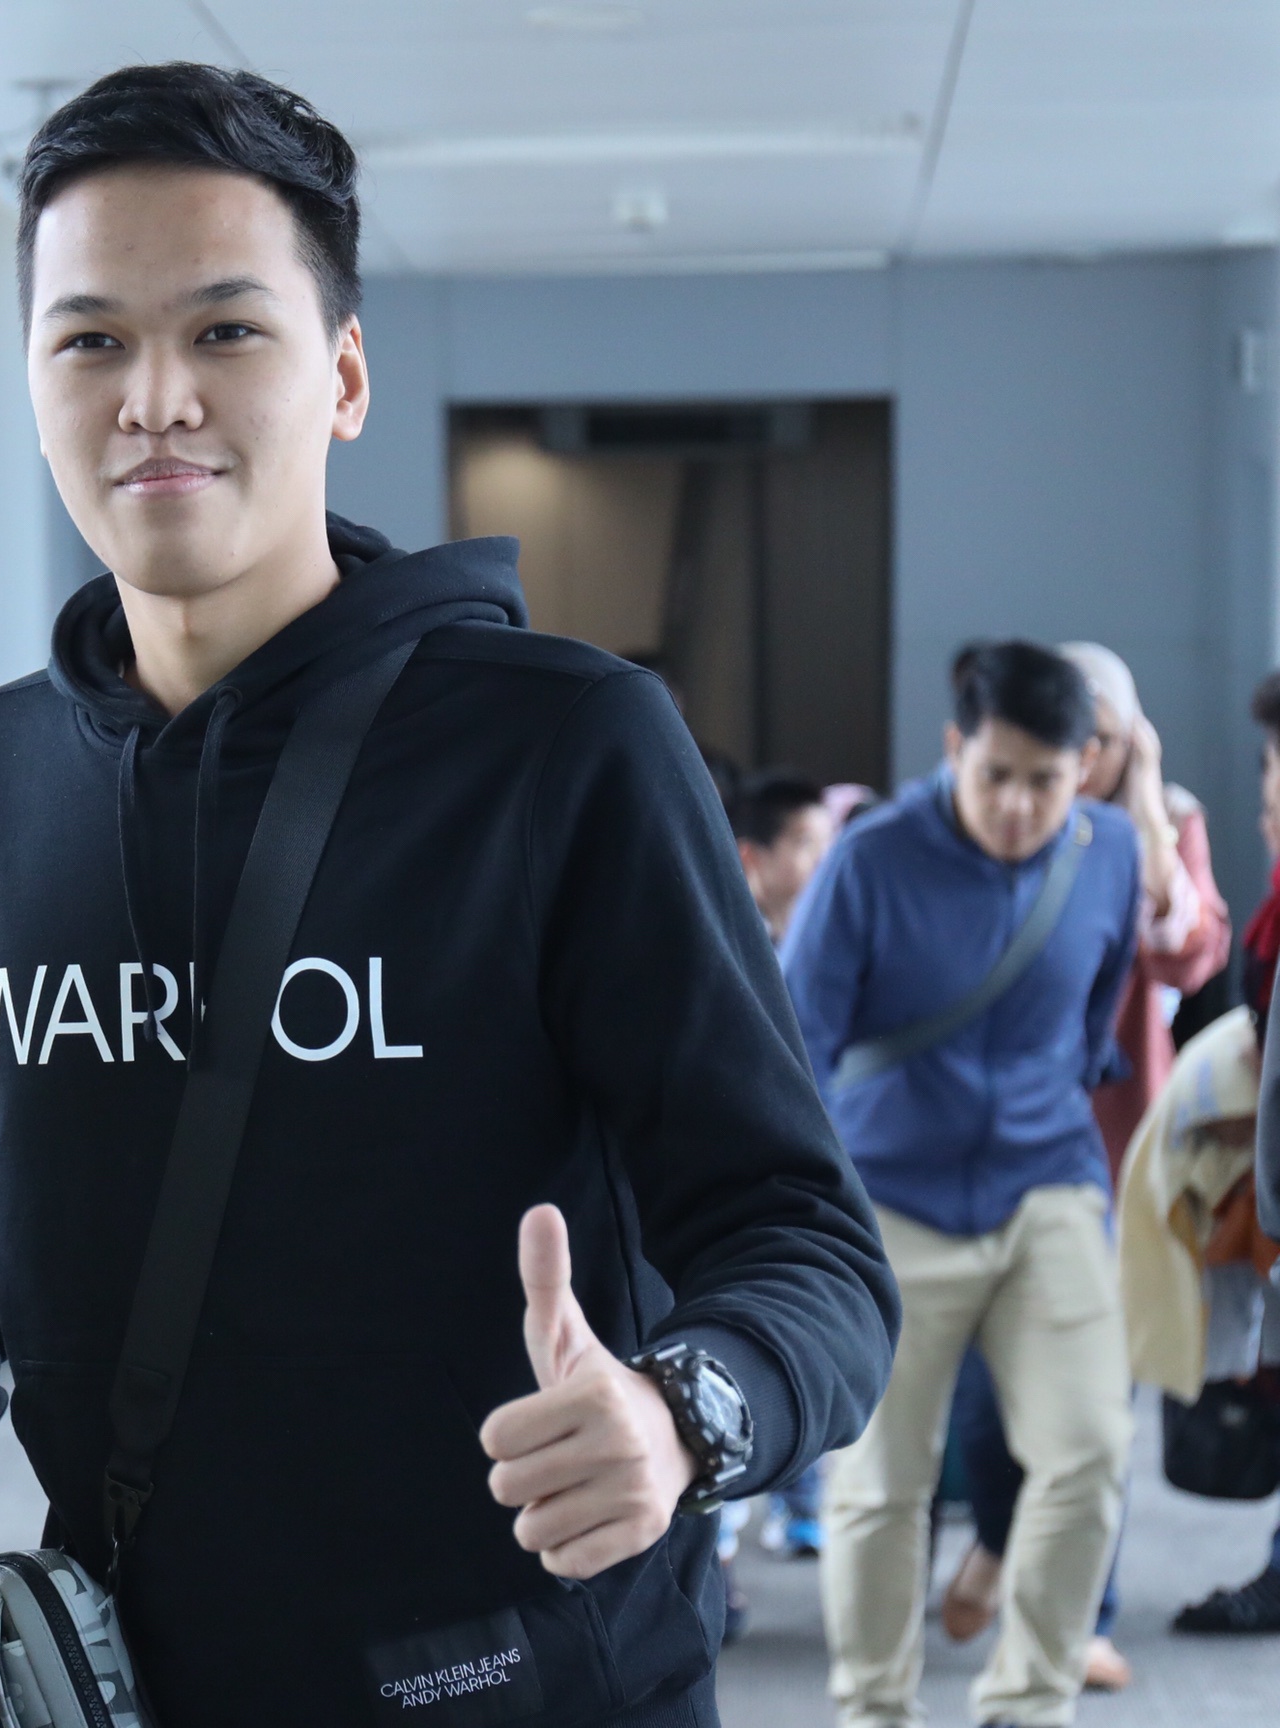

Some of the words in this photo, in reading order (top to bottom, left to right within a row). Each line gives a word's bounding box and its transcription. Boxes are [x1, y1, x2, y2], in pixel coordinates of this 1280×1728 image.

[380, 1673, 433, 1698] CALVIN
[435, 1661, 475, 1685] KLEIN
[477, 1648, 521, 1674] JEANS
[402, 1687, 442, 1709] ANDY
[444, 1668, 511, 1698] WARHOL
